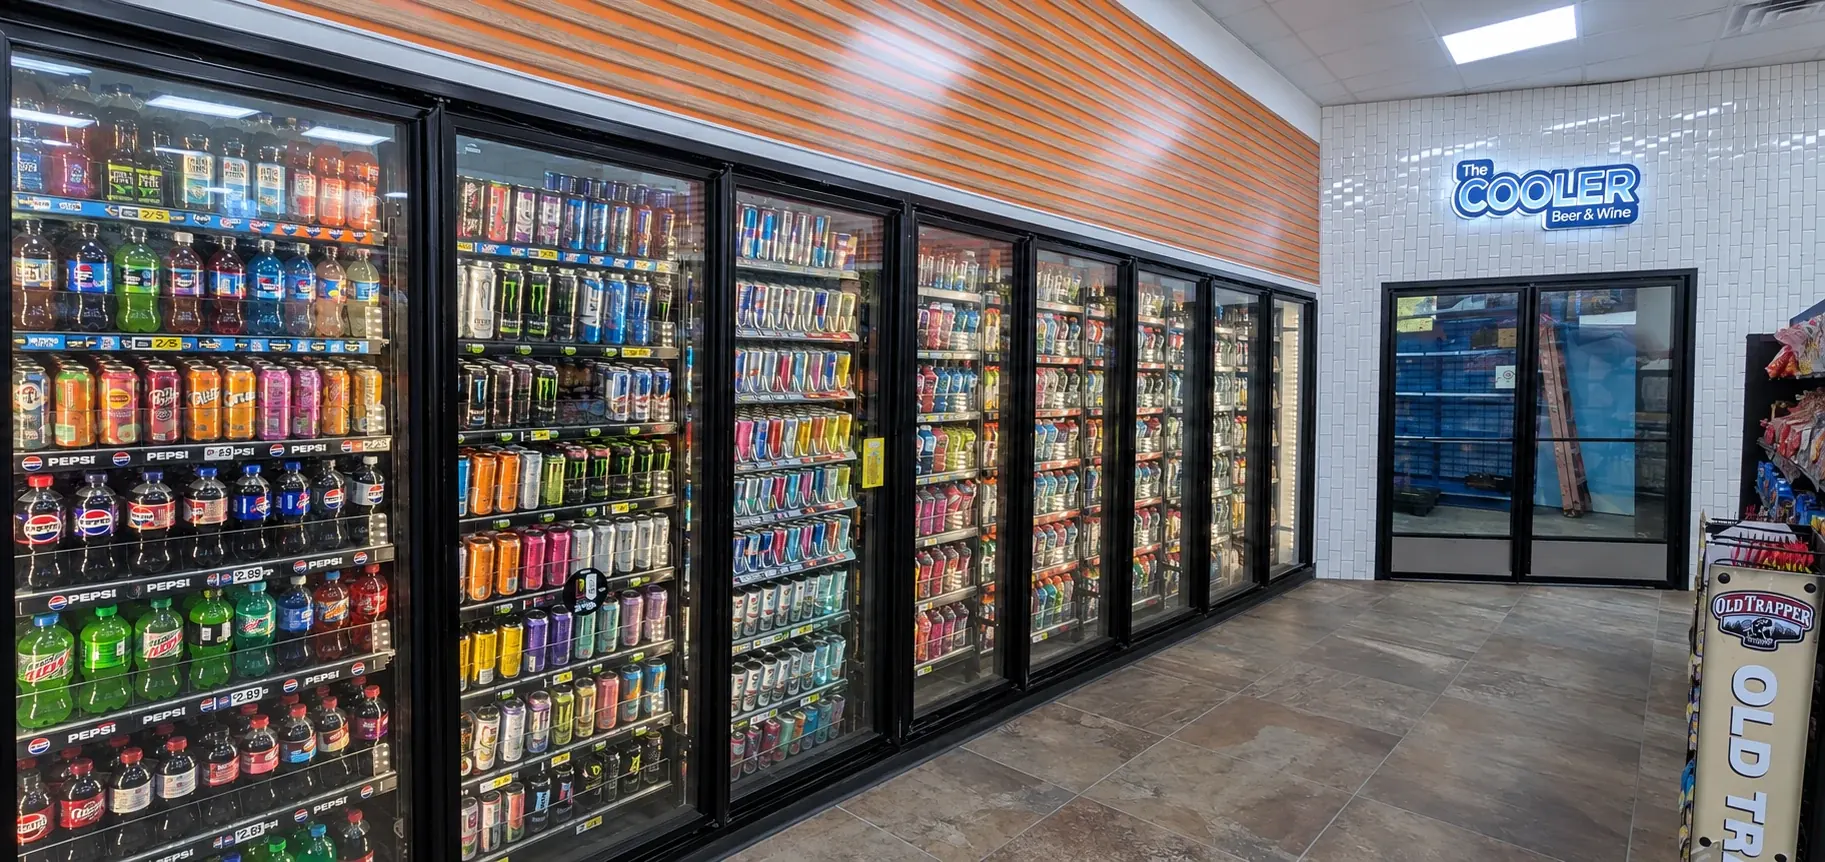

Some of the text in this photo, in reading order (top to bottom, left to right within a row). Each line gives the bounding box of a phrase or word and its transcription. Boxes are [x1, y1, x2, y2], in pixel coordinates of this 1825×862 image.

[1462, 164, 1488, 177] The
[1458, 168, 1635, 213] COOLER
[1552, 207, 1631, 222] Beer & Wine
[147, 451, 189, 461] PEPSI
[291, 444, 327, 454] PEPSI
[48, 455, 96, 467] PEPSI
[308, 557, 343, 569] PEPSI
[147, 578, 190, 592] PEPSI
[68, 589, 117, 604] PEPSI
[1715, 595, 1811, 627] OLD TRAPPER
[305, 670, 340, 685] PEPSI
[143, 706, 186, 724] PEPSI
[1728, 664, 1778, 779] OLD
[68, 723, 116, 743] PEPSI
[313, 796, 348, 814] PEPSI
[1721, 791, 1767, 862] TR
